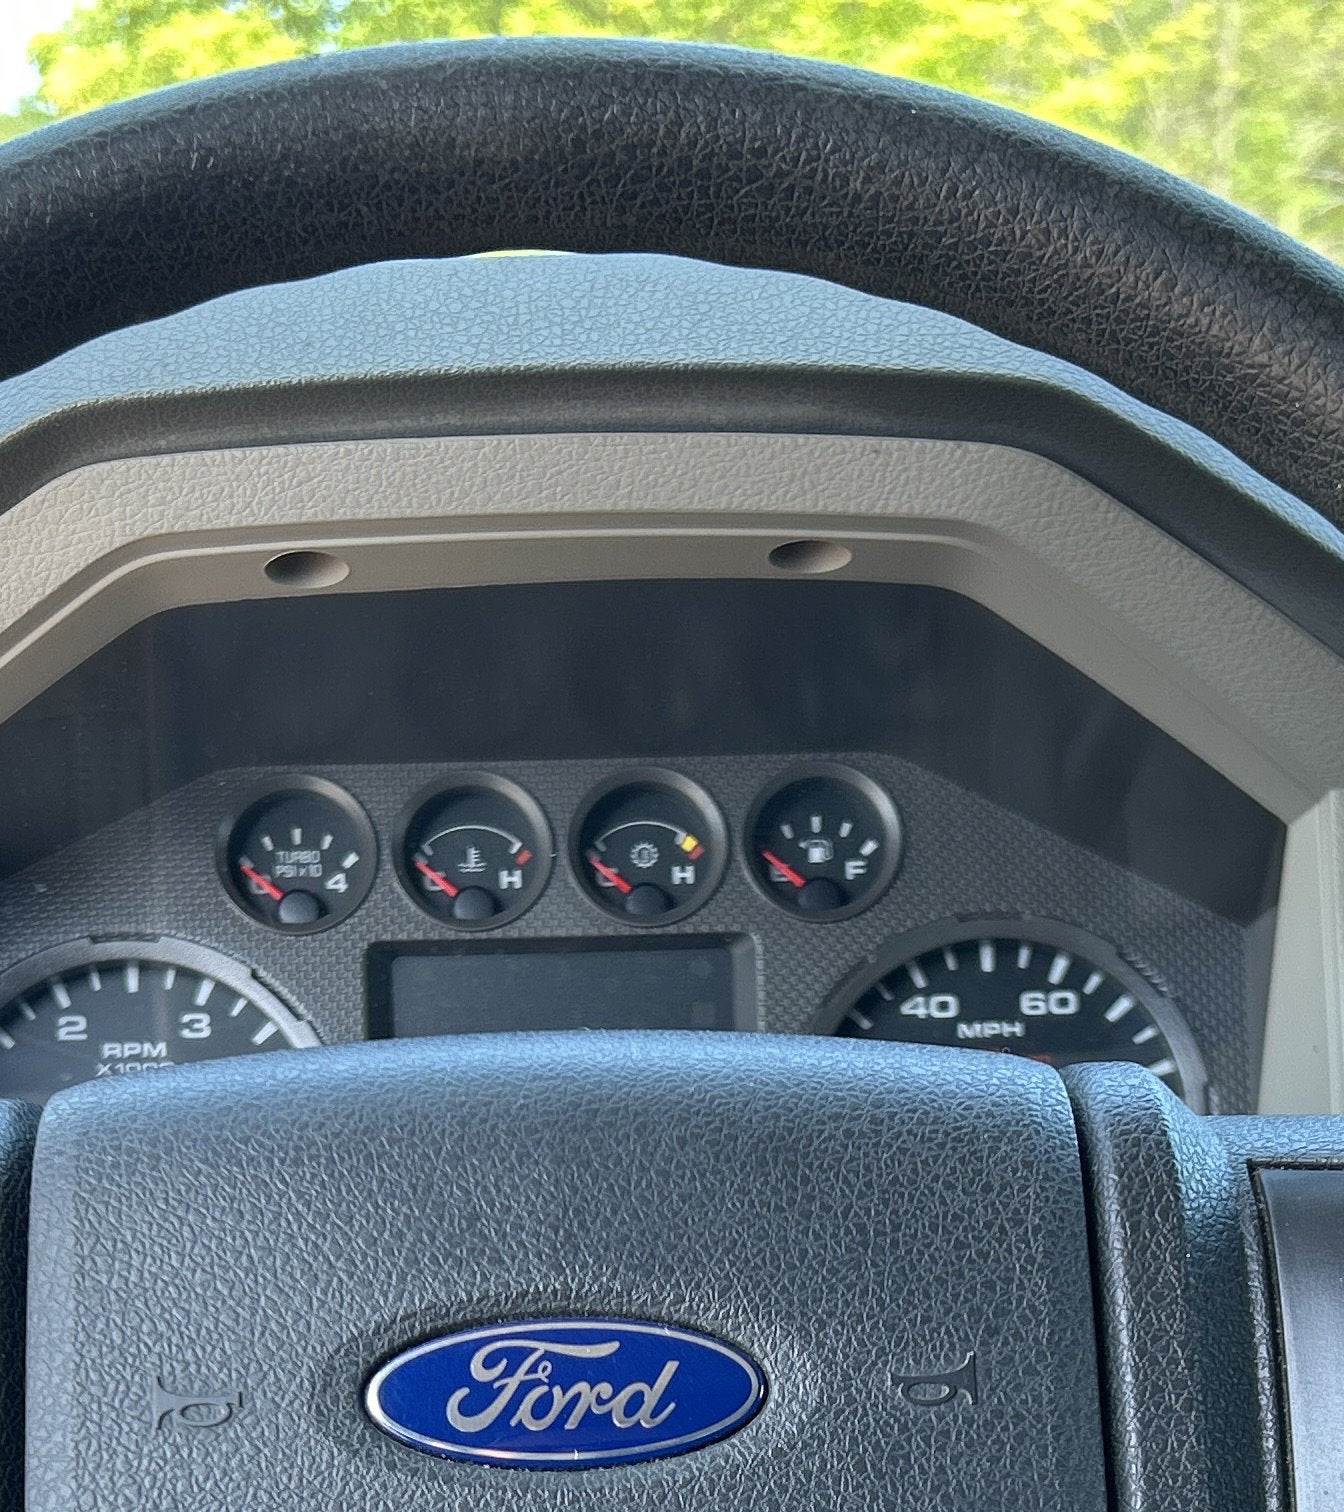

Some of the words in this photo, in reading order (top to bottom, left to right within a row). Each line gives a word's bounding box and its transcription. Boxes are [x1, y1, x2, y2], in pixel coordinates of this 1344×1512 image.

[274, 849, 321, 864] TURBO
[274, 865, 297, 878] PSI
[499, 869, 523, 889] H
[671, 865, 696, 885] H
[844, 860, 868, 880] F
[324, 872, 348, 893] 4
[899, 995, 960, 1020] 40
[1019, 991, 1080, 1016] 60
[57, 1015, 88, 1041] 2
[179, 1012, 212, 1039] 3
[956, 1021, 1025, 1039] MPH
[102, 1041, 168, 1059] RPM
[445, 1338, 680, 1434] Ford
